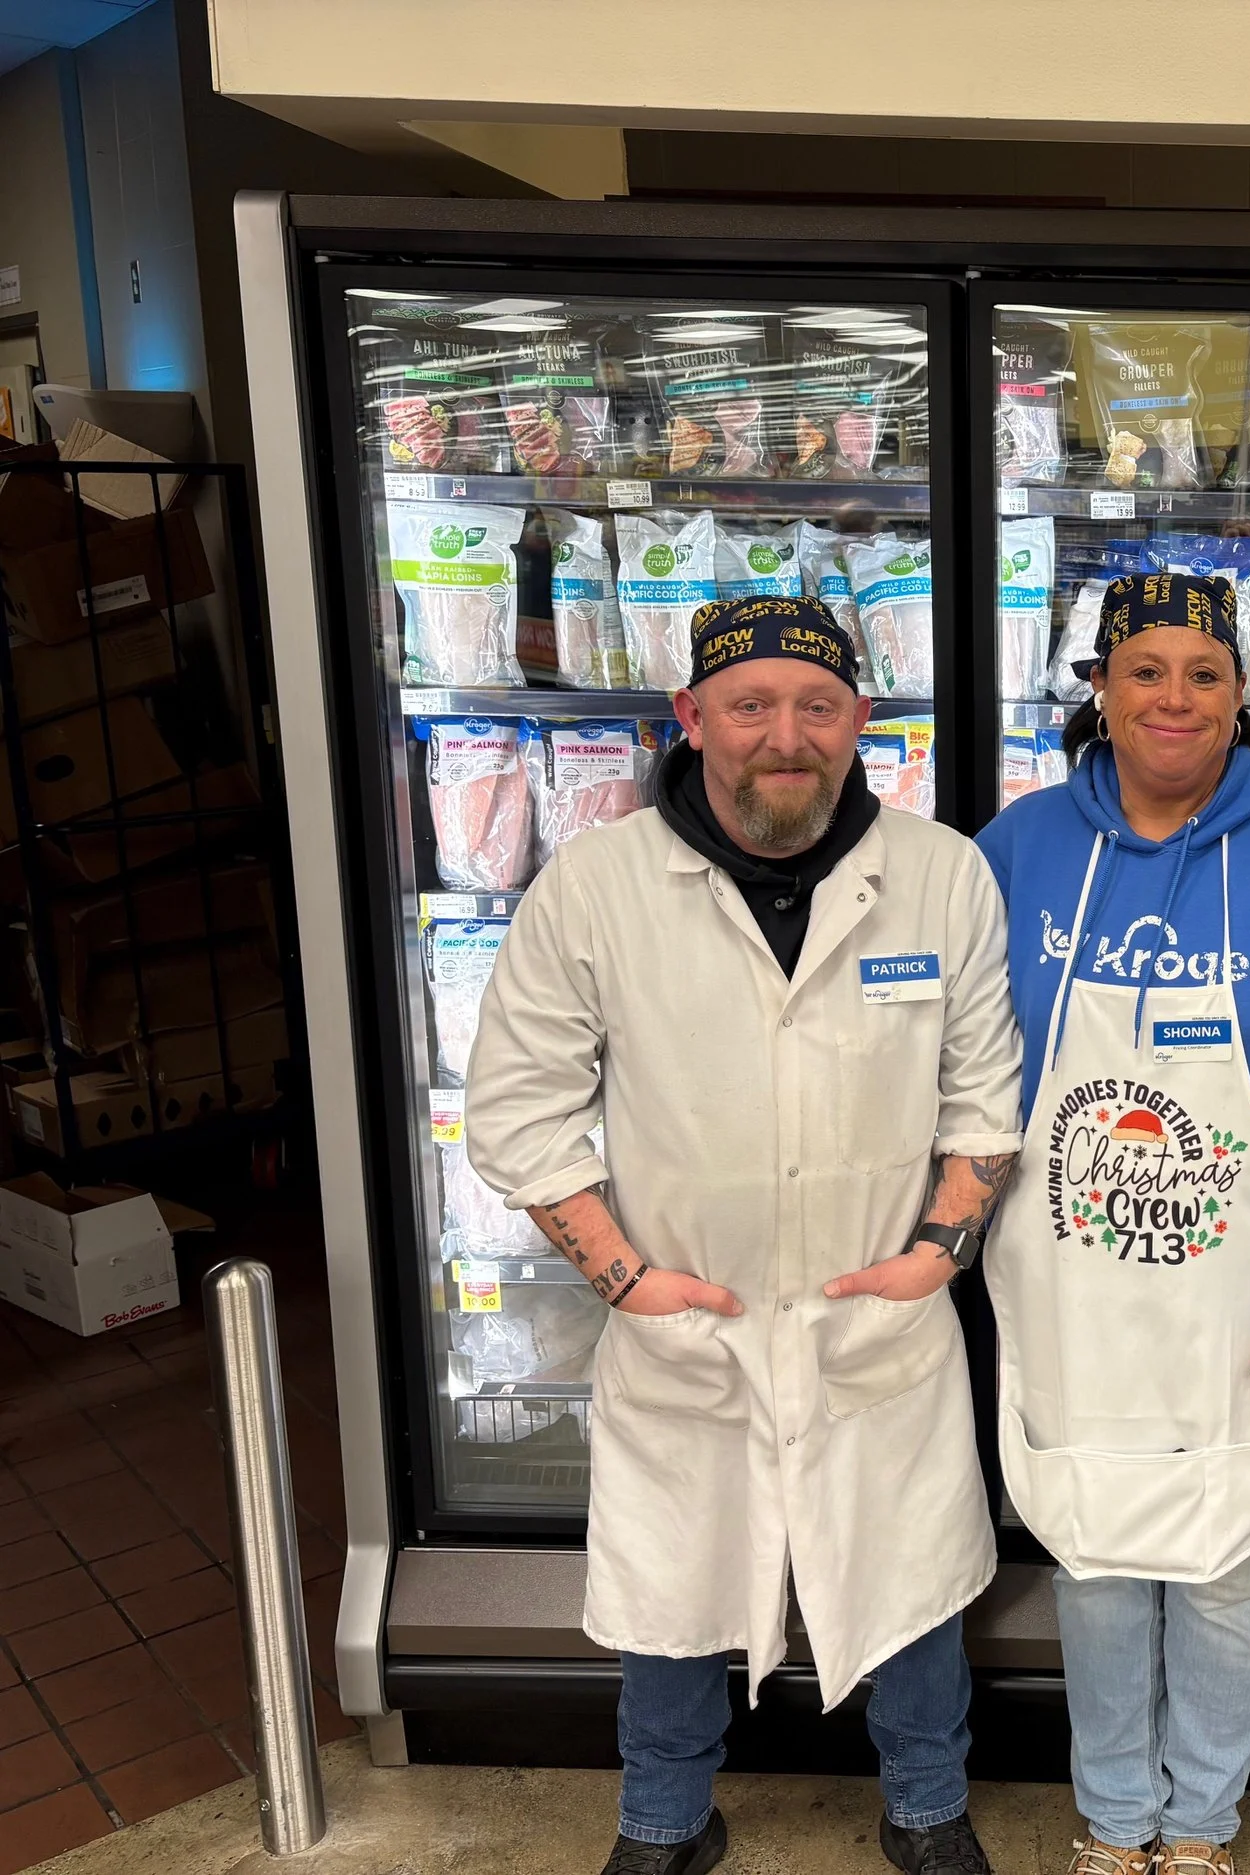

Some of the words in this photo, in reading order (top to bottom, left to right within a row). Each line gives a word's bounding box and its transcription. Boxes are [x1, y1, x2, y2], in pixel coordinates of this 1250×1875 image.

[1140, 347, 1169, 357] CAUGHT
[536, 362, 565, 372] STEAKS
[1119, 362, 1174, 380] GROUPER
[1134, 381, 1160, 392] FILLETS
[1116, 508, 1133, 517] 13.99
[647, 560, 672, 568] truth
[452, 573, 482, 582] LOINS
[560, 588, 584, 597] LOINS
[656, 590, 676, 598] COD
[865, 587, 899, 602] PACIFIC
[900, 584, 921, 593] COD
[1187, 588, 1202, 630] UFCW
[1202, 593, 1212, 614] 227
[703, 650, 726, 671] Local
[729, 641, 754, 658] 227
[780, 639, 820, 657] Local
[824, 652, 841, 668] 227
[910, 732, 930, 740] BIG
[470, 741, 509, 750] SALMON
[560, 746, 581, 754] PINK
[583, 746, 623, 754] SALMON
[871, 960, 927, 976] PATRICK
[1163, 1026, 1221, 1039] SHONNA
[1050, 1078, 1118, 1154] MEMORIES
[1123, 1080, 1204, 1163] TOGETHER
[1066, 1126, 1242, 1196] Christmas
[1048, 1158, 1071, 1241] MAKING
[1106, 1188, 1200, 1230] Crew
[1115, 1229, 1186, 1266] 713
[592, 1258, 628, 1299] GY6
[466, 1297, 496, 1306] 10.00
[101, 1312, 130, 1328] Bob
[130, 1301, 164, 1320] Evans
